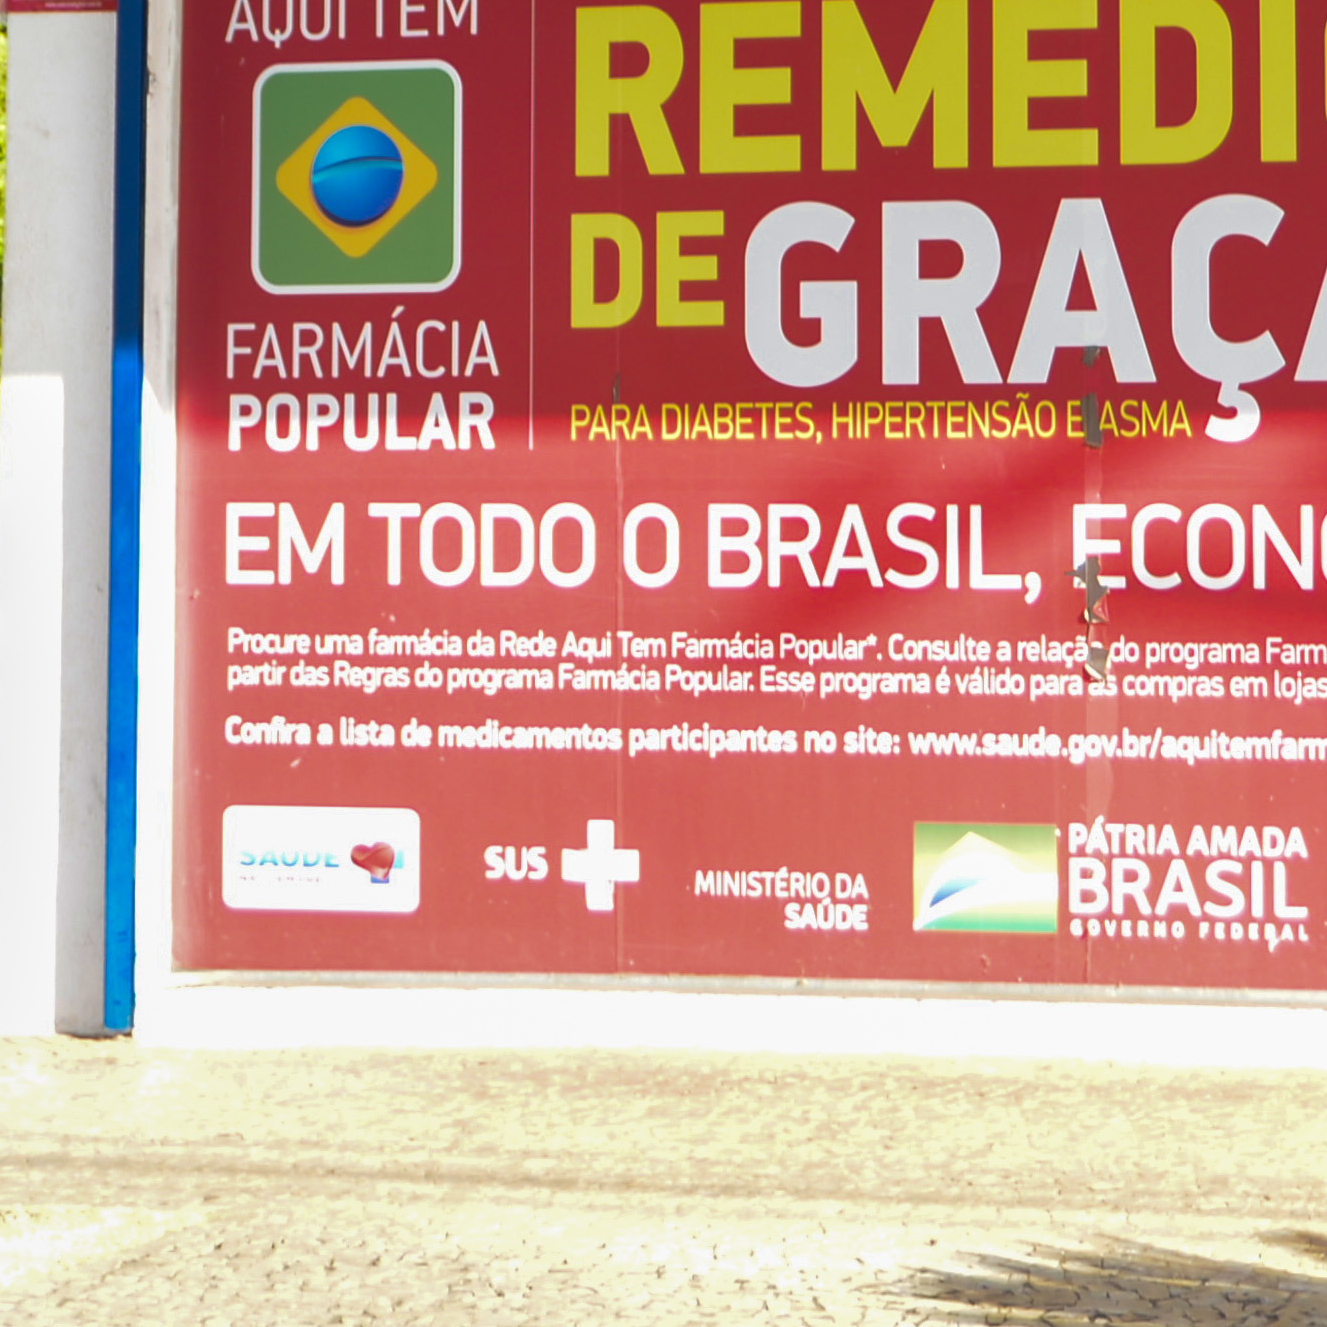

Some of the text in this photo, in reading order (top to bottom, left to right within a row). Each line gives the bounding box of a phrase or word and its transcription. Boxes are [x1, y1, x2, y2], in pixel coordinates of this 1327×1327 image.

[571, 209, 725, 328] DE
[226, 306, 499, 379] FARMÁCIA
[228, 392, 496, 452] POPULAR
[570, 393, 1192, 443] PARA DIABETES, HIPERTENSÃO E ASMA
[225, 501, 345, 586] EM
[368, 502, 595, 588] TODO
[622, 502, 679, 588] O
[707, 502, 1042, 604] BRASIL,
[228, 628, 310, 659] Procure
[315, 636, 363, 656] uma
[369, 629, 461, 656] farmácia
[467, 630, 495, 657] da
[500, 631, 558, 657] Rede
[562, 631, 611, 663] Aqui
[617, 633, 666, 659] Tem
[671, 632, 773, 659] Farmácia
[888, 634, 991, 662] Consulte
[997, 641, 1011, 662] a
[1110, 637, 1139, 663] do
[1146, 643, 1260, 669] programa
[228, 661, 285, 690] partir
[290, 661, 329, 687] das
[334, 661, 409, 694] Regras
[415, 661, 443, 687] do
[447, 667, 553, 695] programa
[559, 663, 660, 691] Farmácia
[665, 664, 755, 697] Popular.
[760, 665, 814, 691] Esse
[820, 674, 930, 699] programa
[935, 667, 951, 694] é
[955, 668, 1025, 695] válido
[1030, 675, 1083, 701] para
[1087, 676, 1117, 697] as
[1122, 676, 1224, 702] compras
[1230, 677, 1269, 699] em
[225, 716, 311, 745] Confira
[316, 723, 334, 746] a
[340, 717, 395, 746] lista
[400, 718, 433, 747] de
[438, 719, 622, 750] medicamentos
[629, 723, 796, 758] participantes
[804, 731, 838, 754] no
[843, 725, 901, 755] site:
[1068, 815, 1309, 858] PÁTRIA AMADA
[484, 845, 548, 881] SUS
[694, 867, 869, 899] MINISTÉRIO DA
[1068, 857, 1309, 919] BRASIL
[784, 898, 868, 930] SAÚDE
[1070, 918, 1309, 941] GOVERNO FEDERAL
